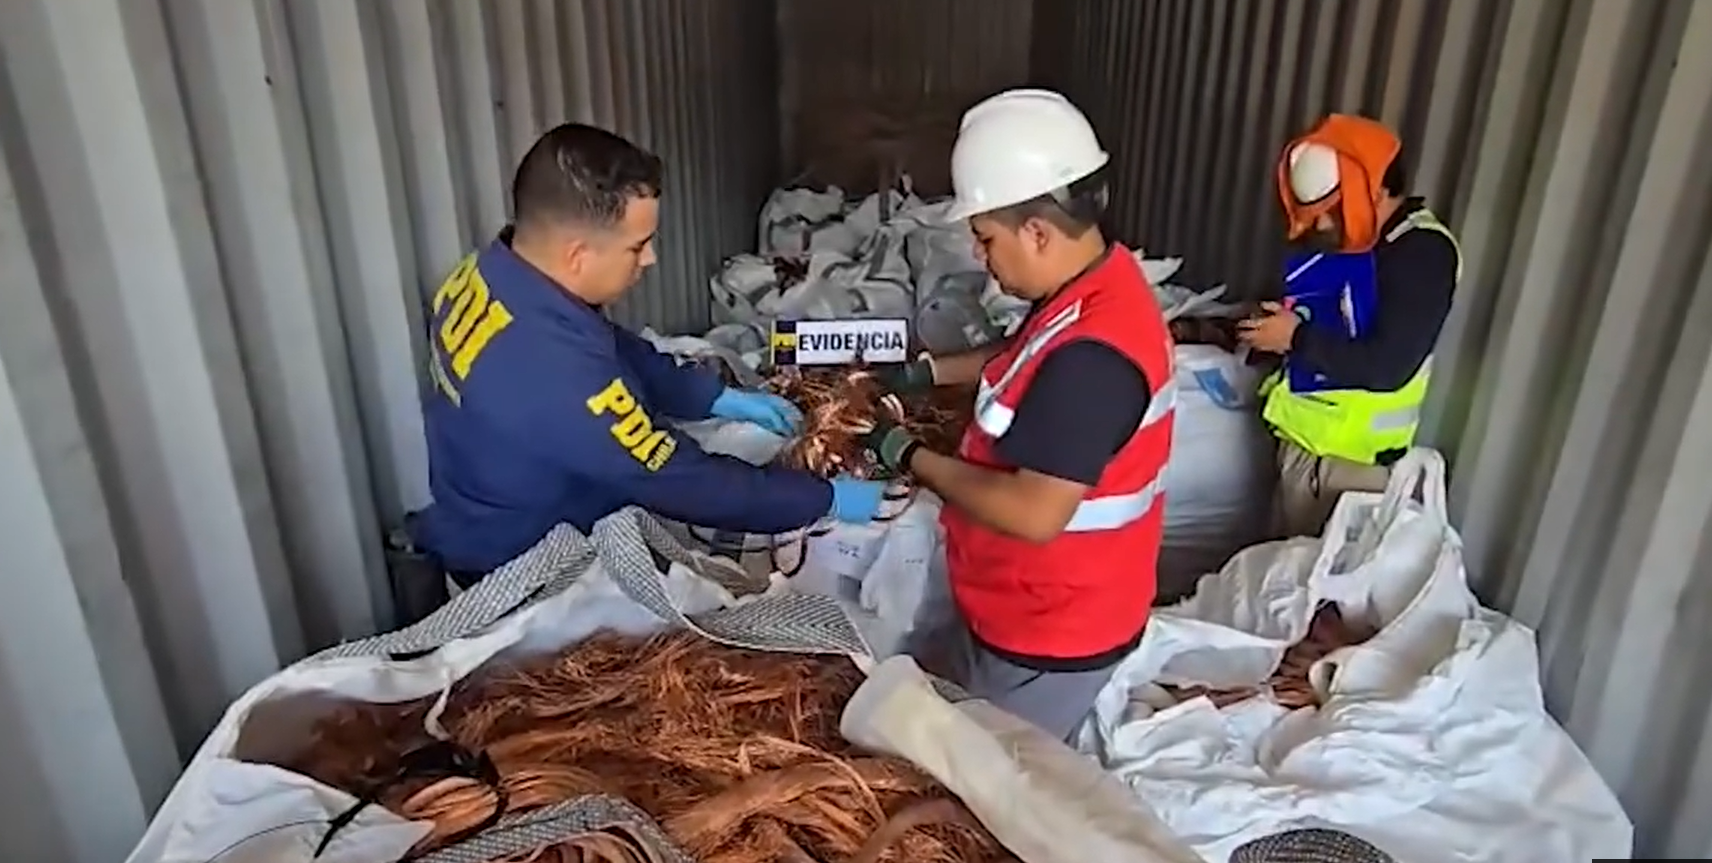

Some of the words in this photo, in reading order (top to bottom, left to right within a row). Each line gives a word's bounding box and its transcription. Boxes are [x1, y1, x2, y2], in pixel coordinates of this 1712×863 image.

[433, 250, 514, 380] PDI
[799, 332, 904, 351] EVIDENCIA
[586, 377, 669, 462] PDI
